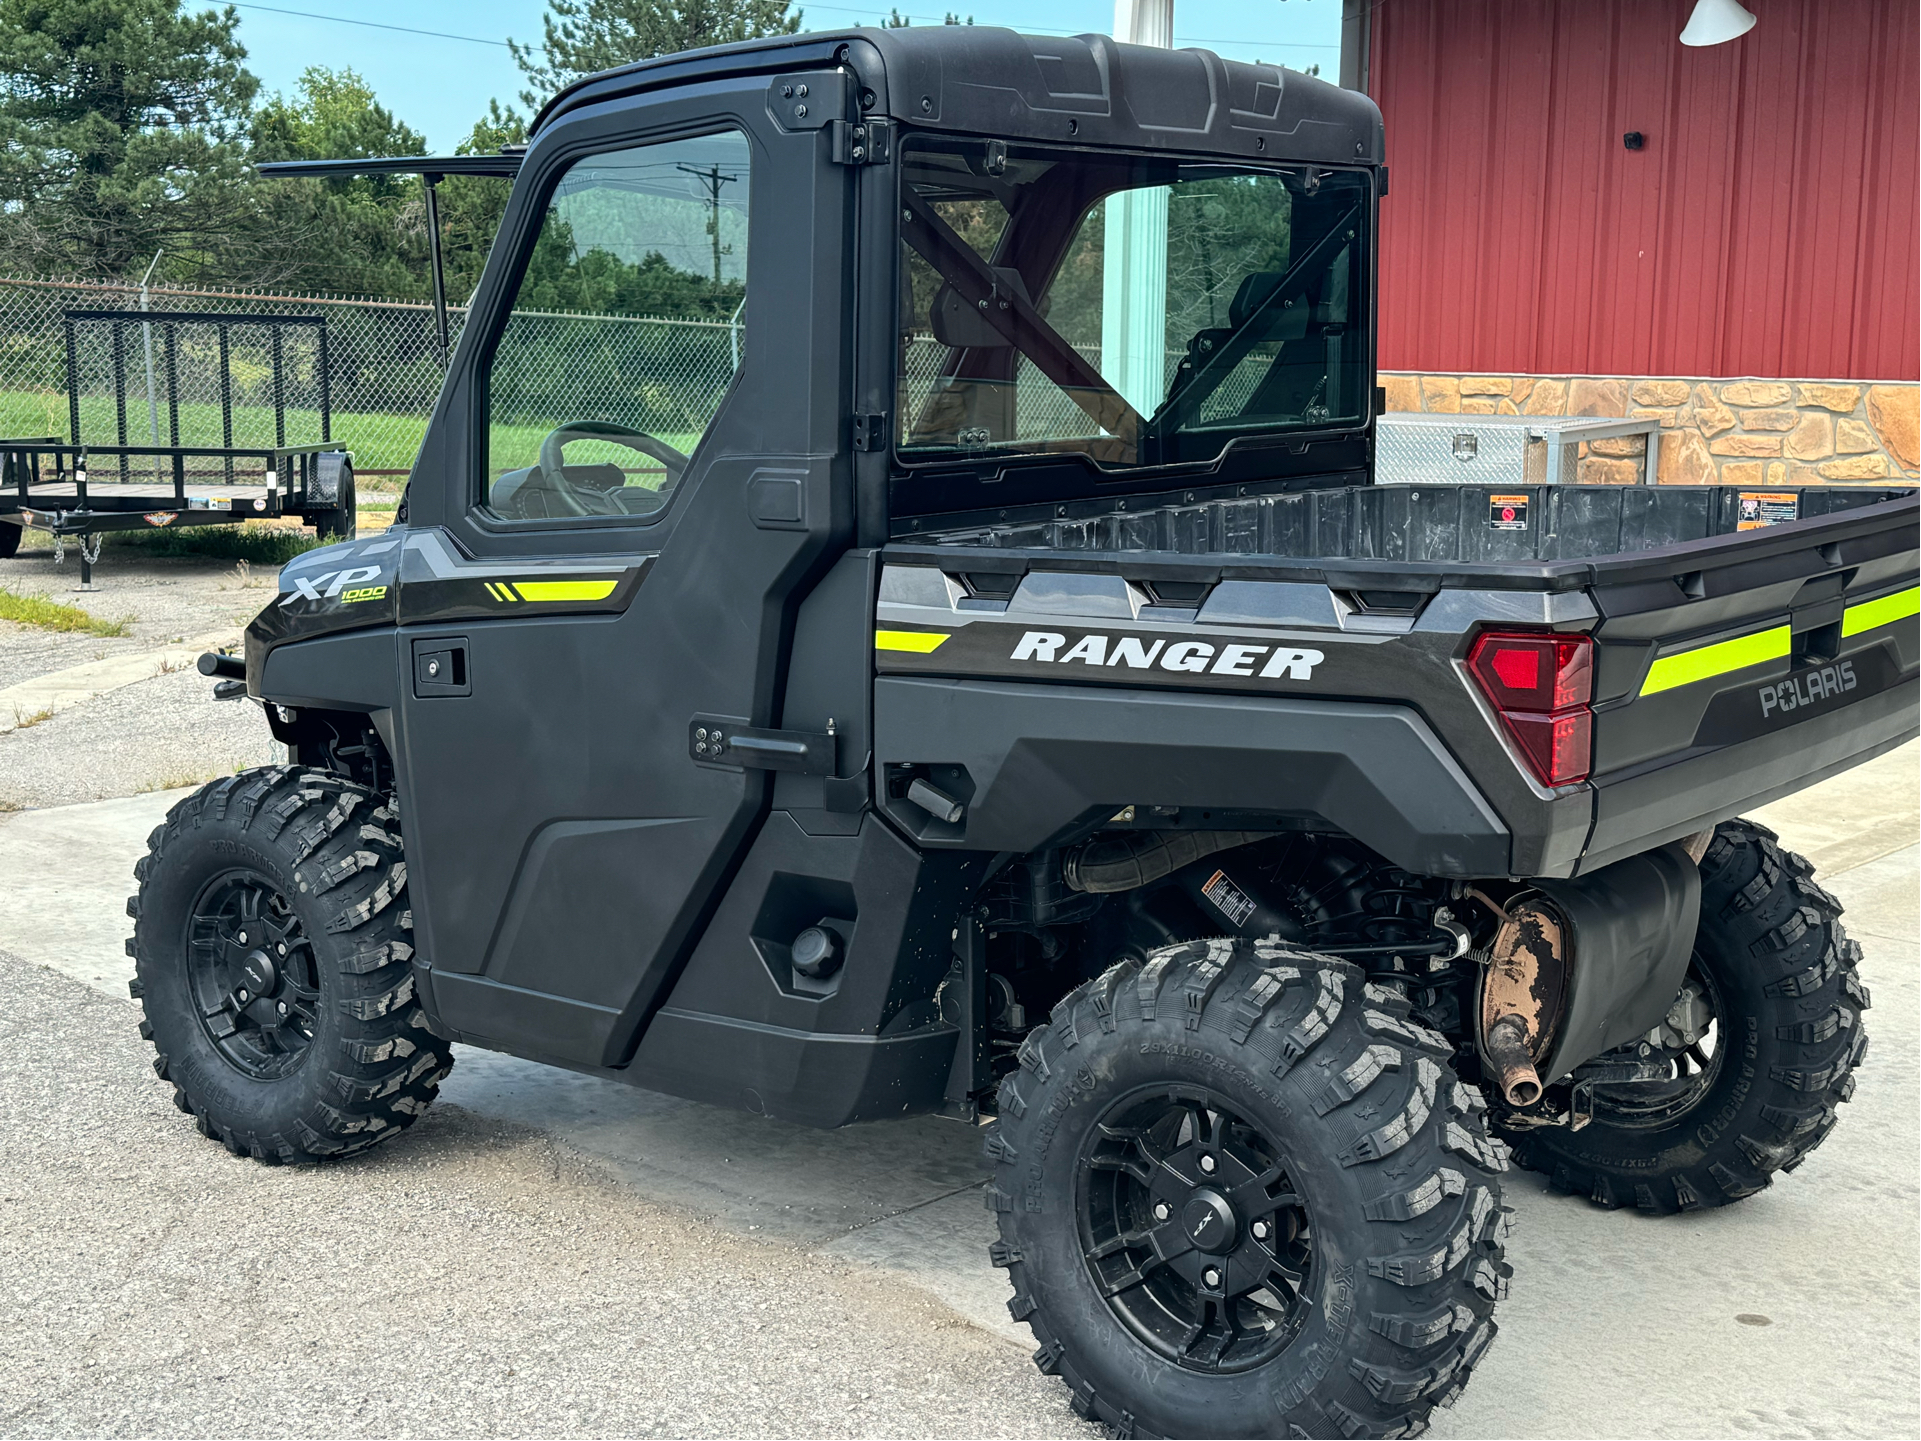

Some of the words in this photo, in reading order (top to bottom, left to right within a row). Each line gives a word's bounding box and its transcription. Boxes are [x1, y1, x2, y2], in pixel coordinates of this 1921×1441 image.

[278, 565, 381, 607] XP
[341, 586, 387, 600] 1000
[1010, 631, 1325, 681] RANGER
[1758, 660, 1857, 718] POLARIS
[1193, 1210, 1213, 1237] XP
